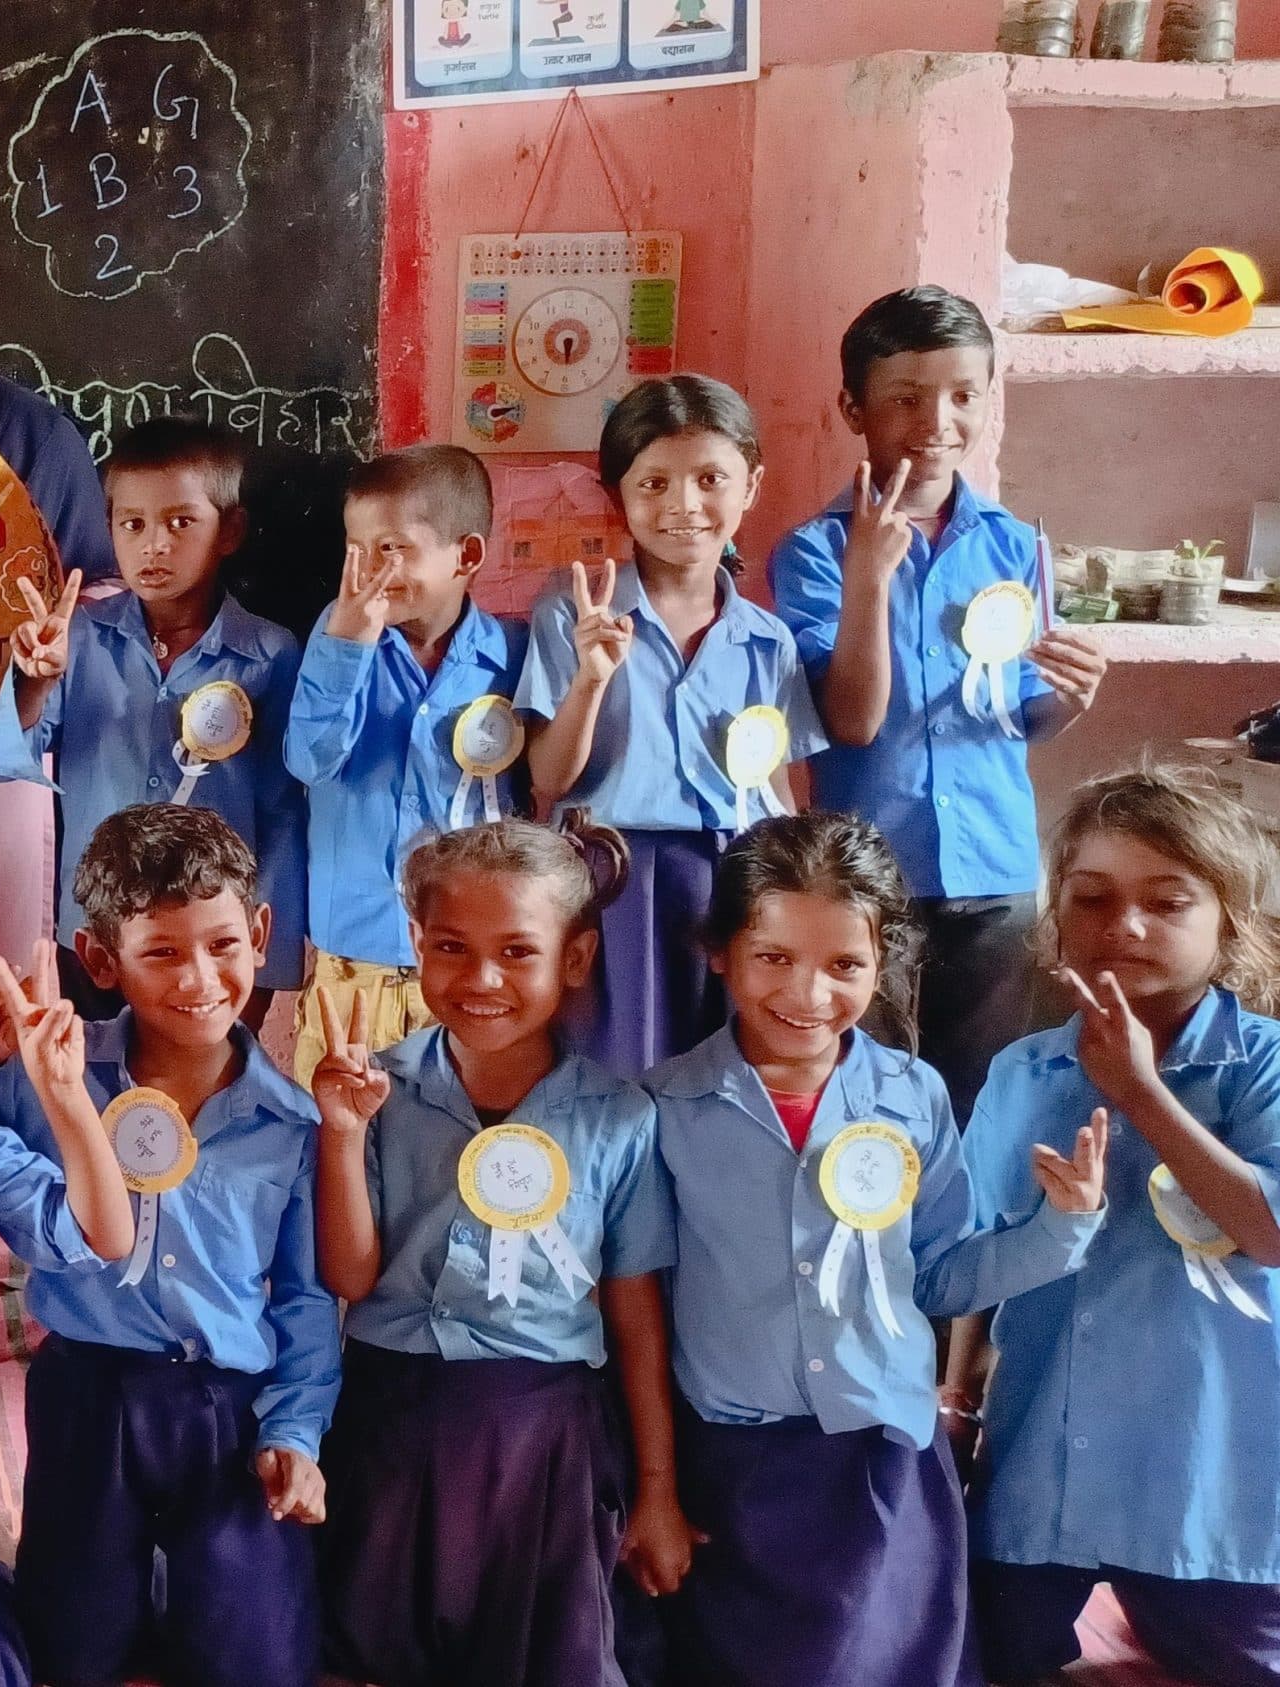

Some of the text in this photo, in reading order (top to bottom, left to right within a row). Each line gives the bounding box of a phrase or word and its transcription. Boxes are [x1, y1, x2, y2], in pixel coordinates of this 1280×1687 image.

[70, 63, 199, 140] A G
[37, 152, 202, 220] 1 B 3
[94, 233, 133, 280] 2
